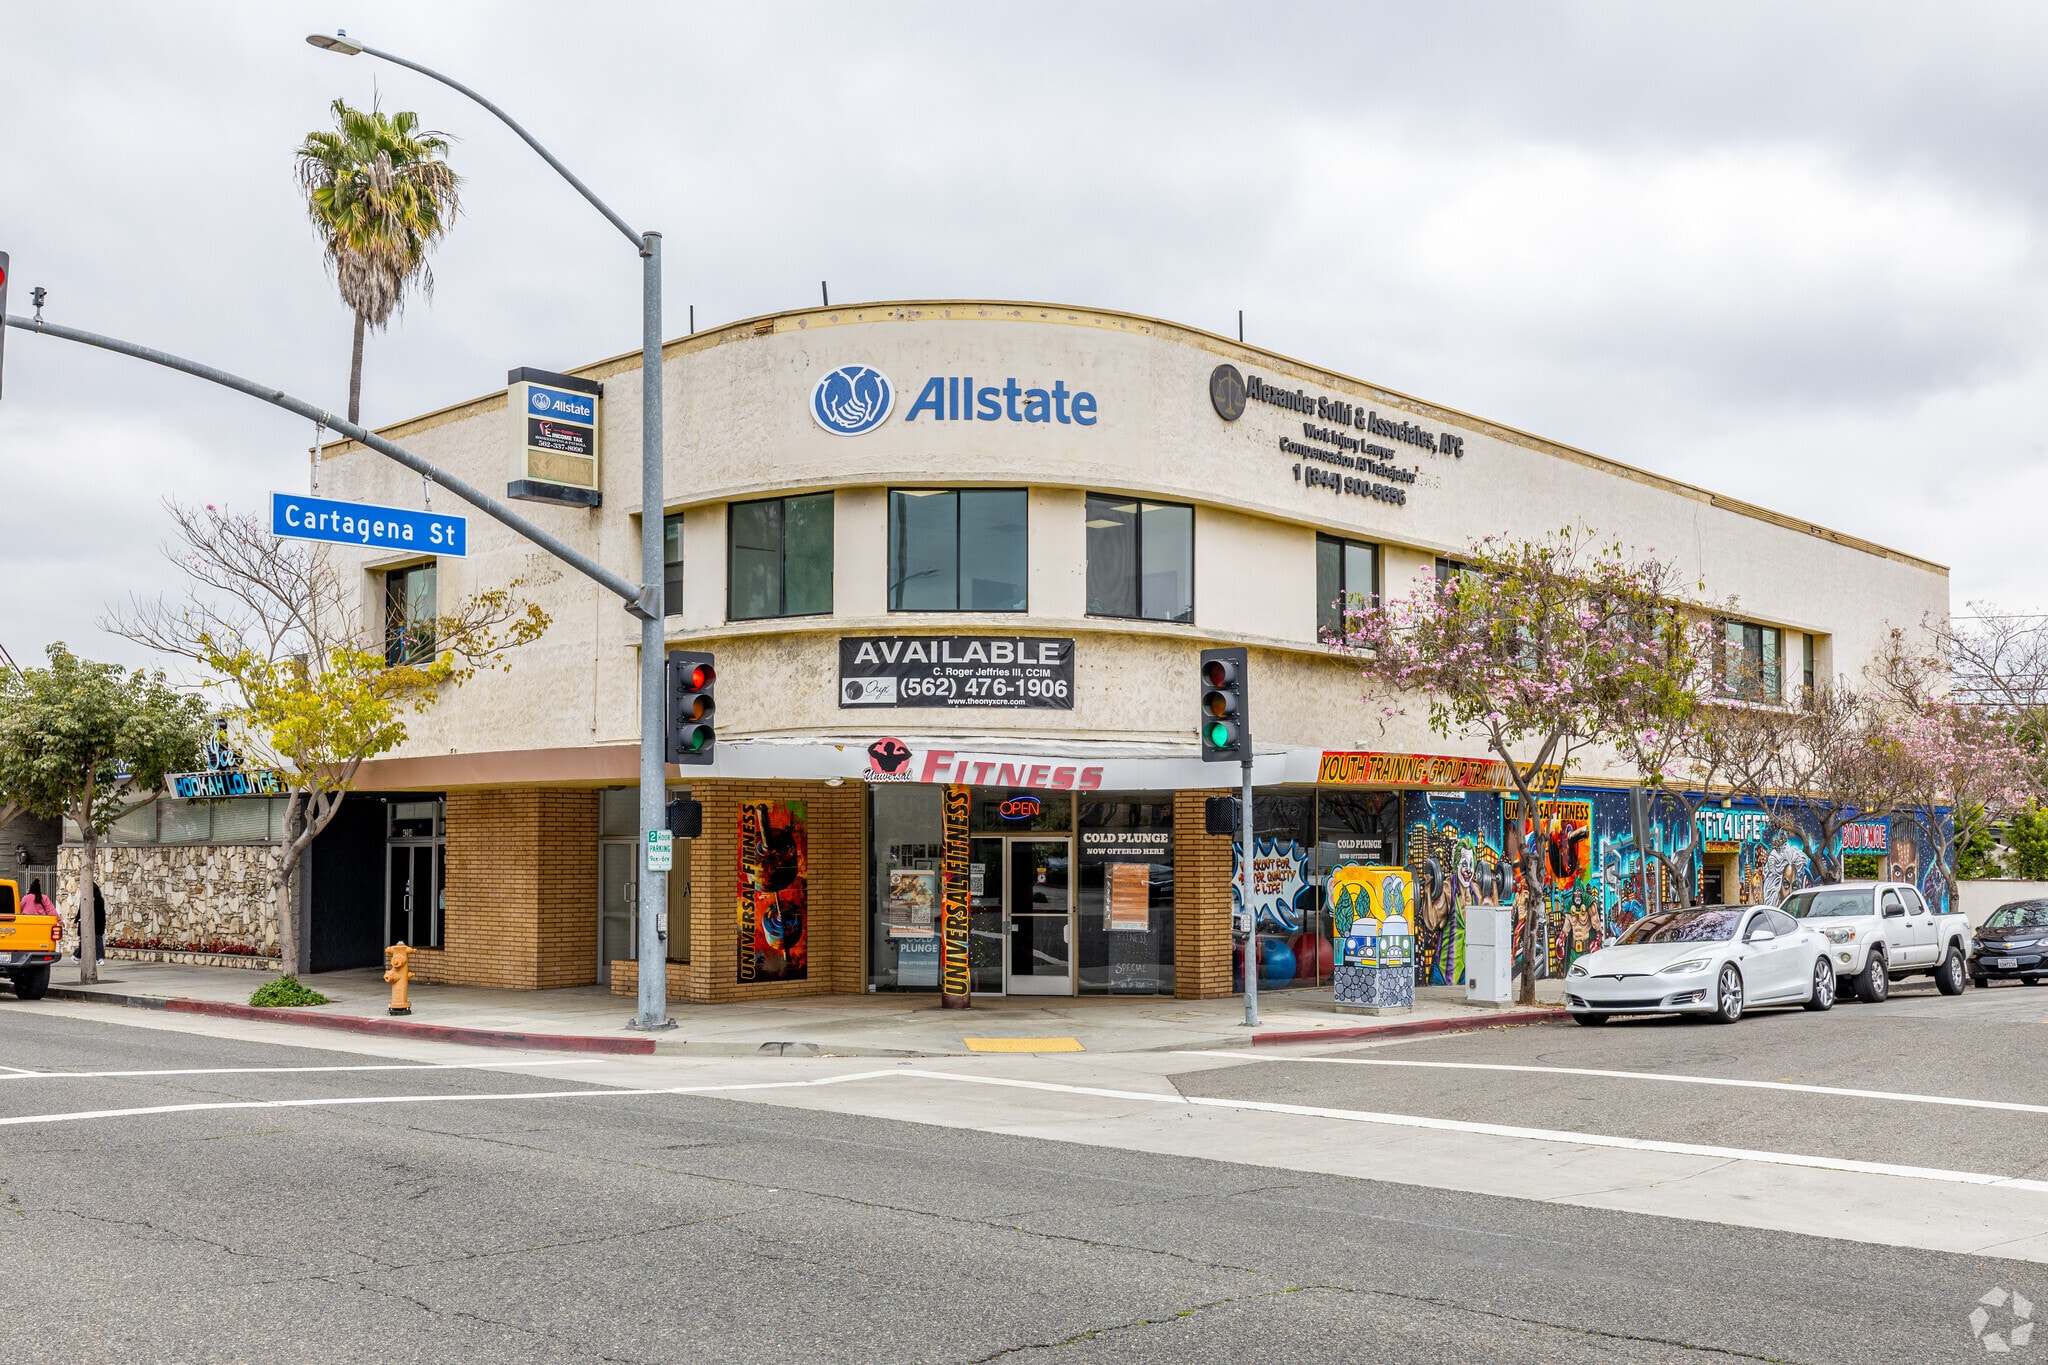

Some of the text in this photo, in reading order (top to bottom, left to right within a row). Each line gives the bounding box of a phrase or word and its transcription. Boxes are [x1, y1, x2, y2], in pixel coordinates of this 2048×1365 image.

[552, 400, 590, 417] Allstate
[905, 376, 1098, 426] Allstate
[1246, 375, 1317, 415] Alexander
[1354, 407, 1366, 429] &
[1367, 411, 1438, 454] Associates,
[1439, 432, 1464, 457] APC
[552, 432, 572, 441] INCOME
[1303, 422, 1395, 460] Work Injury Lawyer
[1279, 436, 1355, 467] Compensacion
[1366, 458, 1416, 483] Trabajador
[1293, 463, 1406, 505] 1 (844) 900-5656
[285, 504, 455, 546] Cartagena St
[854, 640, 1061, 665] AVAILABLE
[933, 667, 944, 676] C.
[945, 667, 974, 679] Roger
[976, 667, 1010, 677] Jeffries
[1026, 668, 1051, 677] CCIM
[866, 680, 889, 700] Onyx
[900, 677, 1068, 698] (562) 476-1906
[947, 698, 1025, 706] www.theonyxcre.com
[863, 750, 1104, 790] Universal FITNESS
[1321, 755, 1367, 781] YOUTH
[1427, 758, 1468, 784] GROUP
[1467, 762, 1515, 788] TRAINING
[174, 771, 279, 798] HOOKAH LOUNGE
[1000, 801, 1040, 815] OPEN
[1556, 804, 1589, 820] FITNESS
[650, 832, 671, 841] 2 HOUR
[1083, 833, 1168, 843] COLD PLUNGE
[1337, 839, 1382, 849] COLD PLUNGE
[1842, 823, 1866, 849] BODY
[650, 845, 671, 853] PARKING
[1239, 858, 1291, 871] RKOUT FOR
[1267, 870, 1296, 883] QUALITY
[741, 803, 756, 980] UNIVERSAL FITNESS
[944, 789, 969, 996] UNIVERSAL FITNESS
[900, 944, 938, 953] PLUNGE
[1115, 962, 1147, 974] SPECIAL
